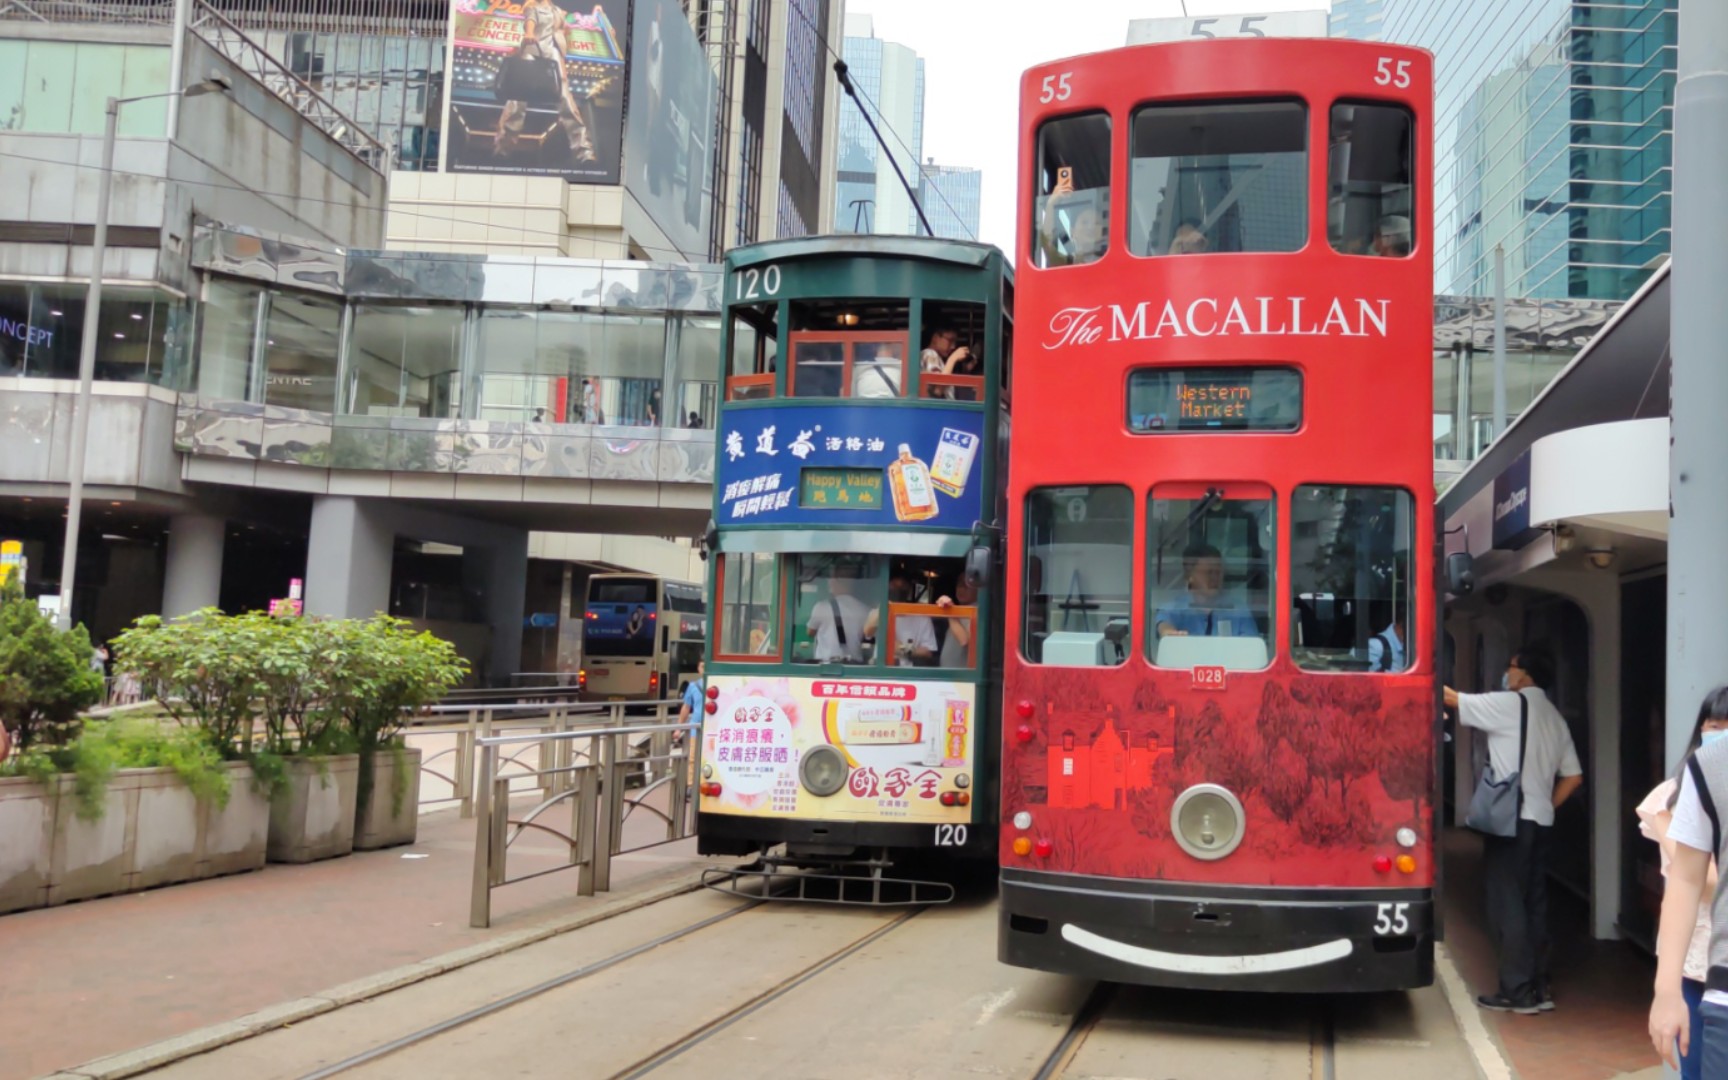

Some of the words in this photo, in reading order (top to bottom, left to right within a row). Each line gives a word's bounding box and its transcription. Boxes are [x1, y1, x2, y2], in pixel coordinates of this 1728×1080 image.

[567, 39, 597, 51] IGHT
[1374, 56, 1412, 88] 55
[1039, 72, 1073, 104] 55
[736, 264, 781, 300] 120
[1041, 305, 1103, 350] The
[1106, 296, 1391, 342] MACALLAN
[1176, 384, 1251, 401] Western
[1181, 401, 1245, 417] Market
[806, 473, 841, 488] Happy
[847, 473, 880, 488] Valley
[1197, 669, 1222, 683] 028
[934, 824, 967, 846] 120
[1373, 902, 1410, 935] 55
